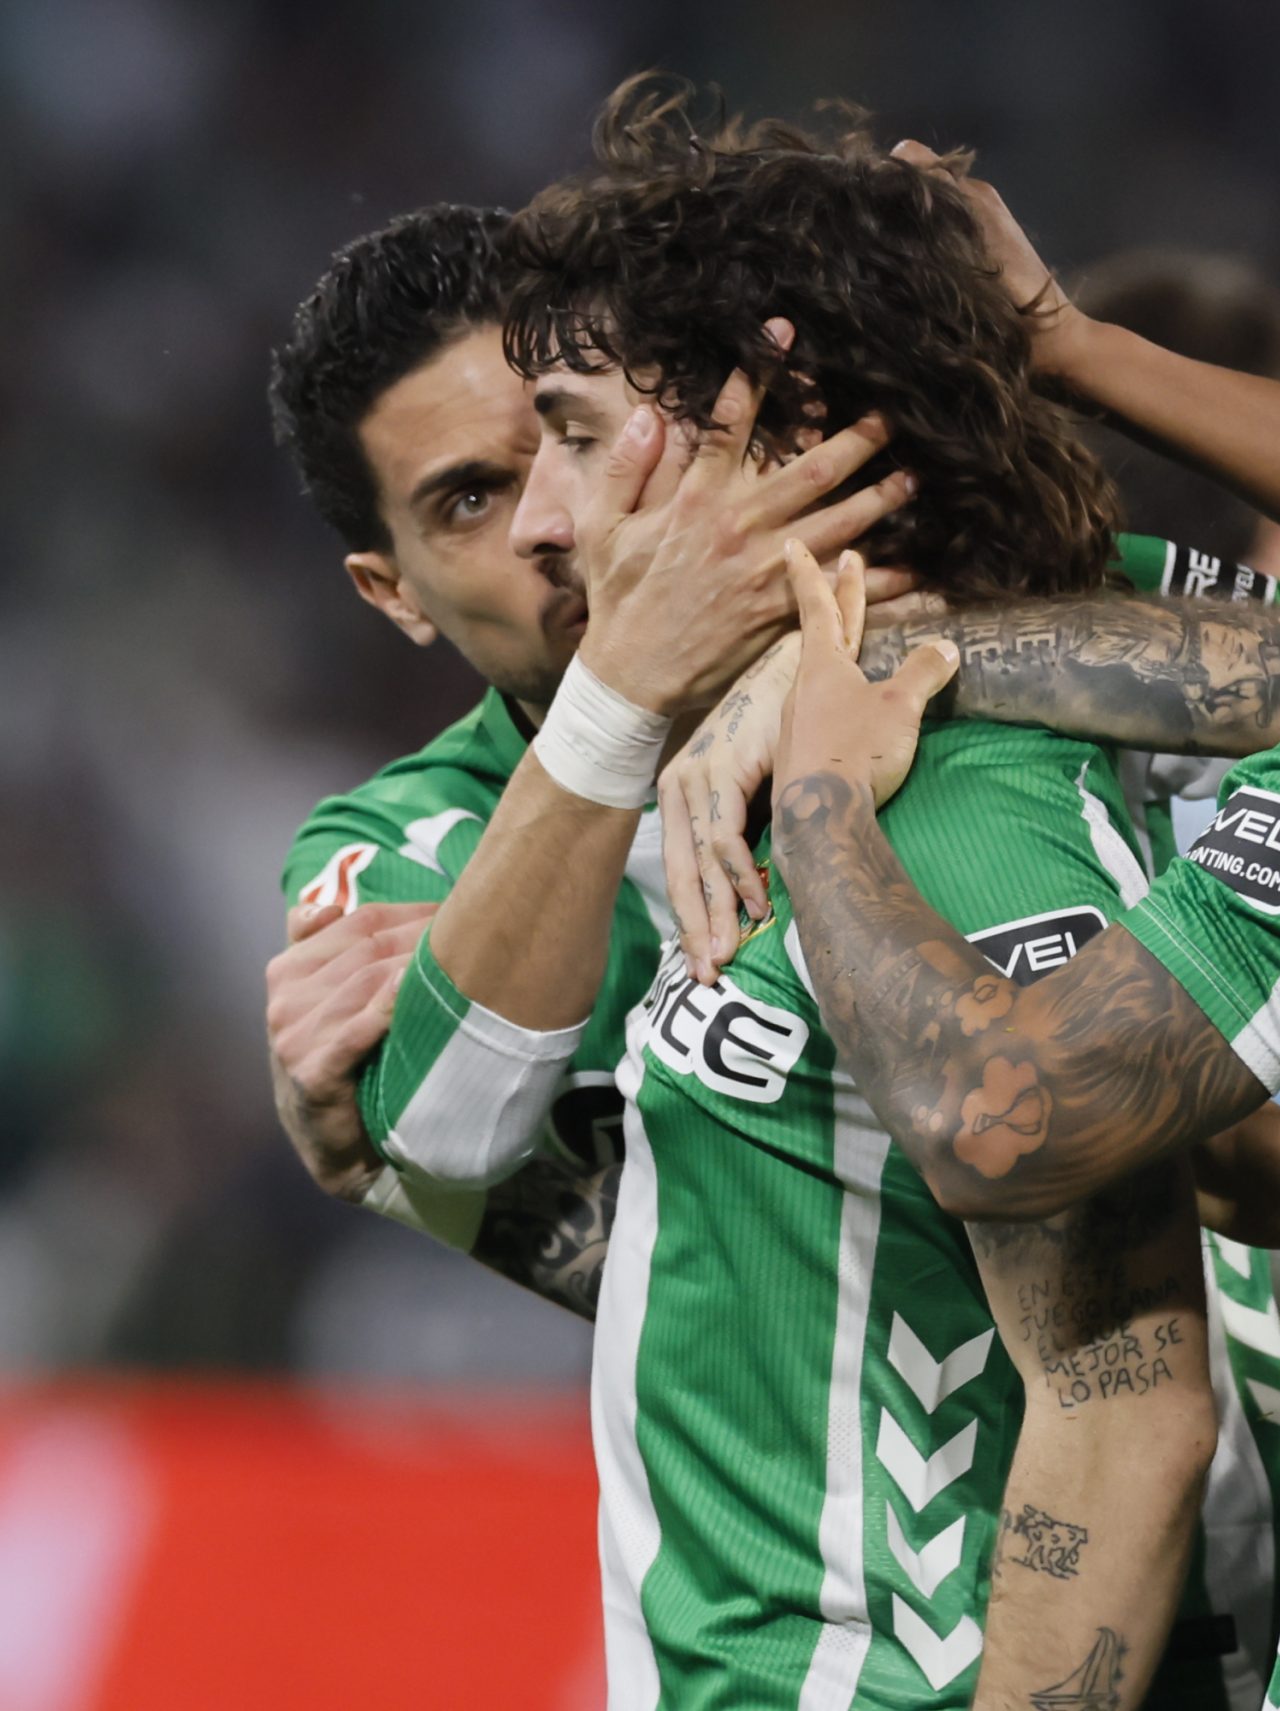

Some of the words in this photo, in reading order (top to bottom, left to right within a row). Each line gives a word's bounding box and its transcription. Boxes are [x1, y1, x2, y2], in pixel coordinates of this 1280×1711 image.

[1043, 1333, 1144, 1388] MEJOR
[1154, 1318, 1185, 1352] SE
[1057, 1380, 1091, 1408] LO
[1098, 1357, 1173, 1399] PASA
